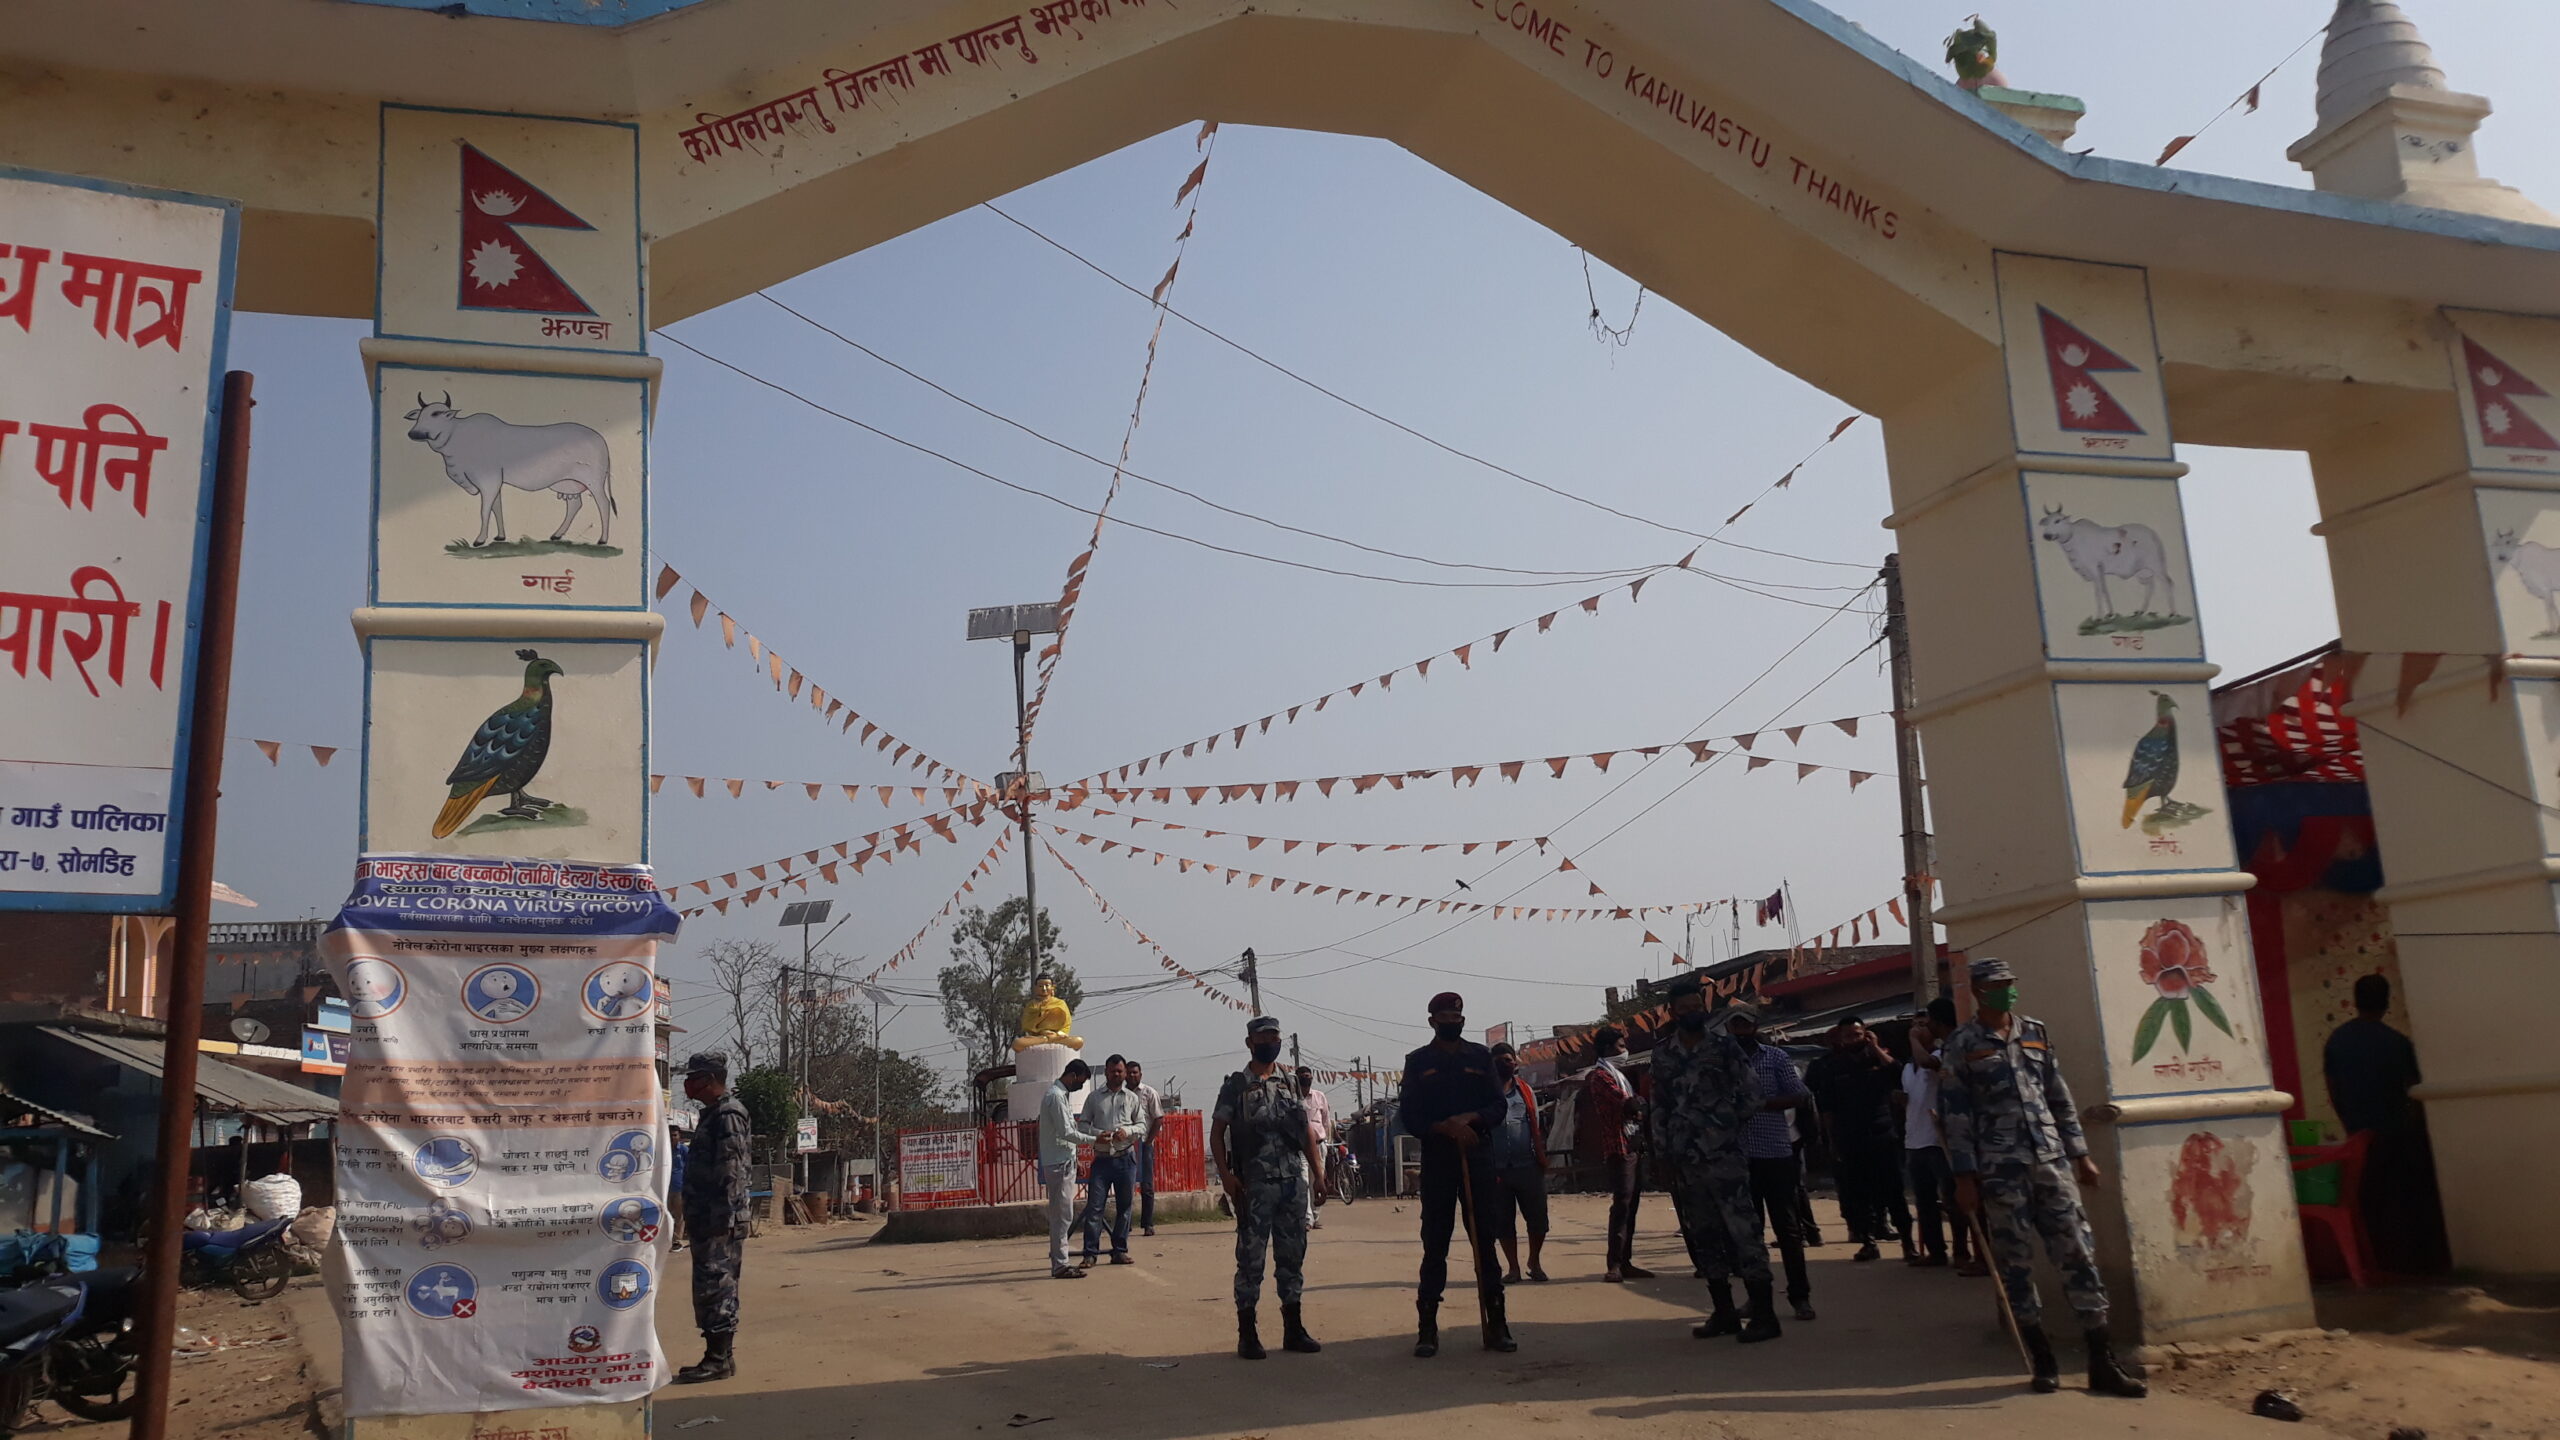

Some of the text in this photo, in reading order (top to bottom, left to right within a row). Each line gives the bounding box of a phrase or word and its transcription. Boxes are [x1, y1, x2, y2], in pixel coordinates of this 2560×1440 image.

[679, 86, 836, 165] कपिलवस्तु
[823, 54, 915, 112] जिल्ला
[912, 43, 951, 76] मा
[1585, 39, 1613, 79] TO
[1624, 65, 1771, 168] KAPILVASTU
[1790, 156, 1898, 239] THANKS
[61, 251, 202, 353] मात्र
[541, 317, 612, 341] झण्डा
[28, 403, 168, 518] पनि
[521, 569, 576, 599] गाई
[11, 803, 167, 832] गाउँ पालिका
[57, 847, 136, 876] सोमडिह
[375, 861, 429, 883] भाइरस
[431, 863, 460, 882] बाट
[517, 863, 556, 886] लागि
[559, 866, 594, 888] हेल्थ
[598, 868, 633, 891] डेस्क
[416, 897, 508, 911] CORONA
[515, 901, 576, 913] VIRUS
[581, 899, 653, 917] (nCOV)
[363, 1110, 400, 1125] कोरोना
